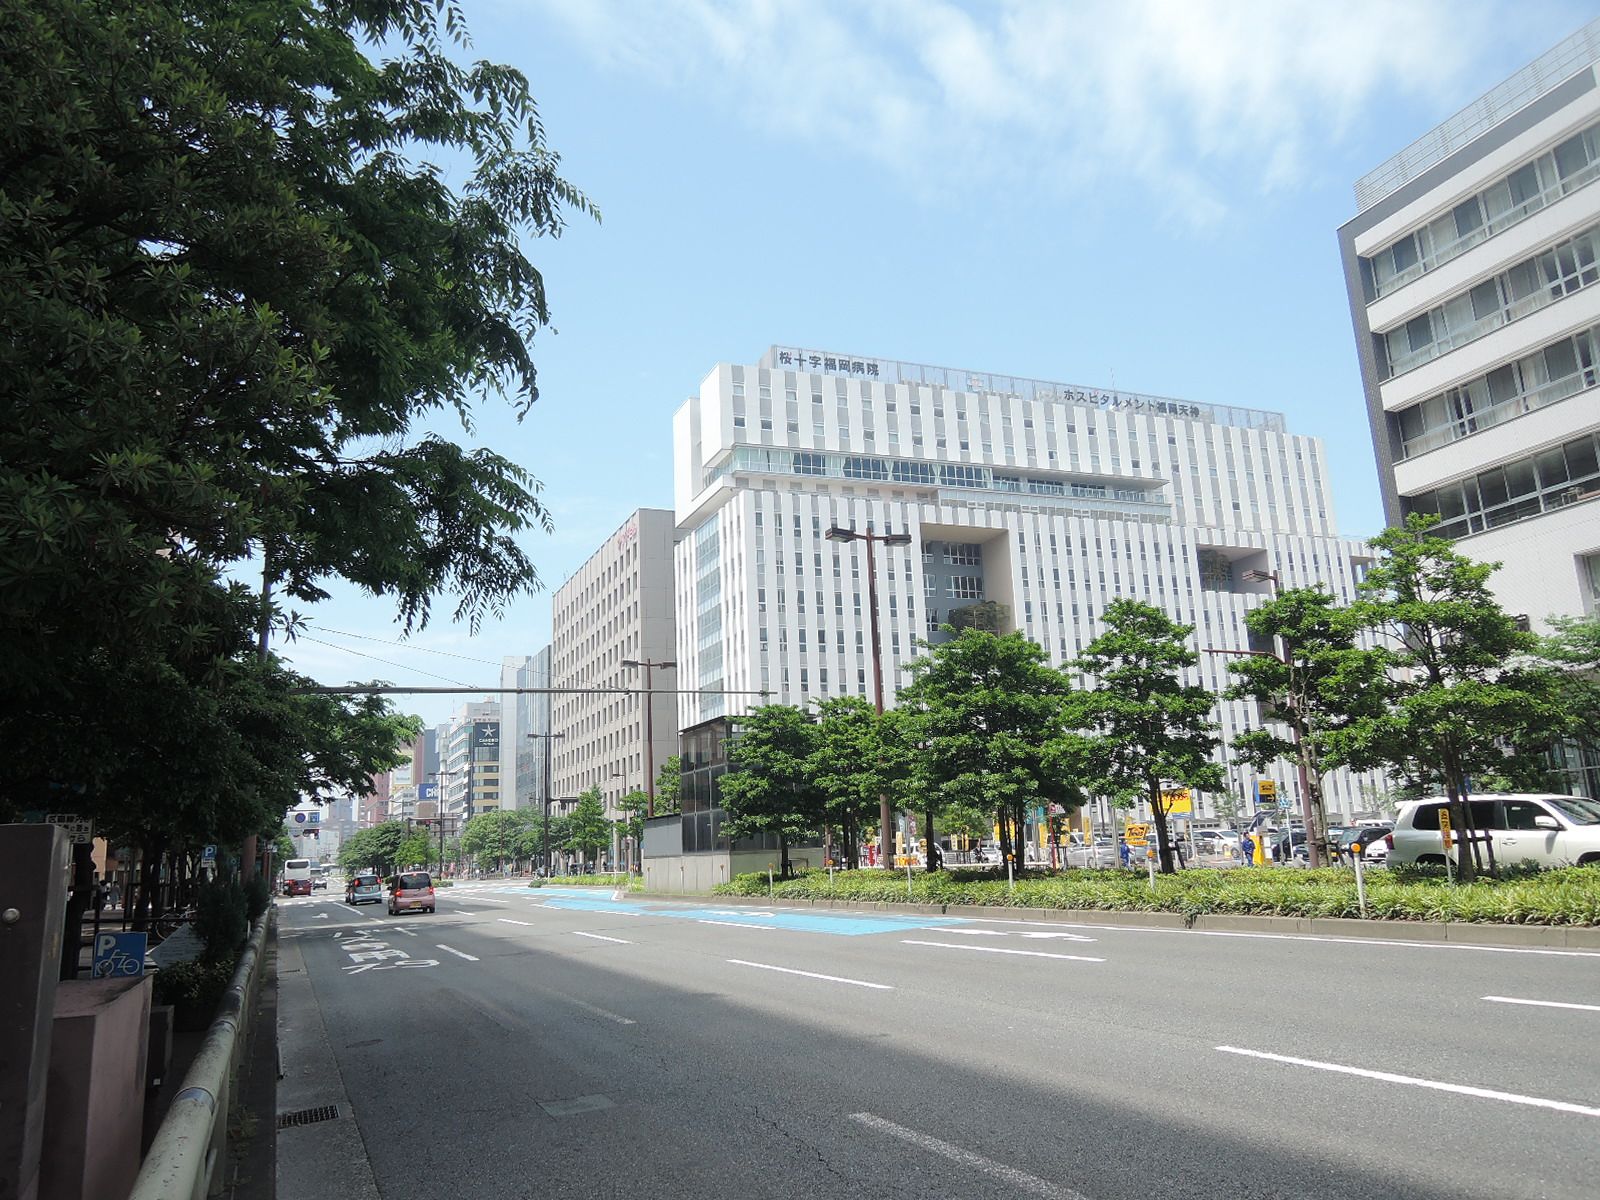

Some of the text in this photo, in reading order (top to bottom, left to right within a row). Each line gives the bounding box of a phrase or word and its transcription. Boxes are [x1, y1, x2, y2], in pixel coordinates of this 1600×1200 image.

[779, 350, 880, 376] 桜十字福岡病院
[1063, 389, 1200, 418] ホスピタルメント福岡天神
[205, 846, 214, 857] P
[97, 935, 116, 957] P
